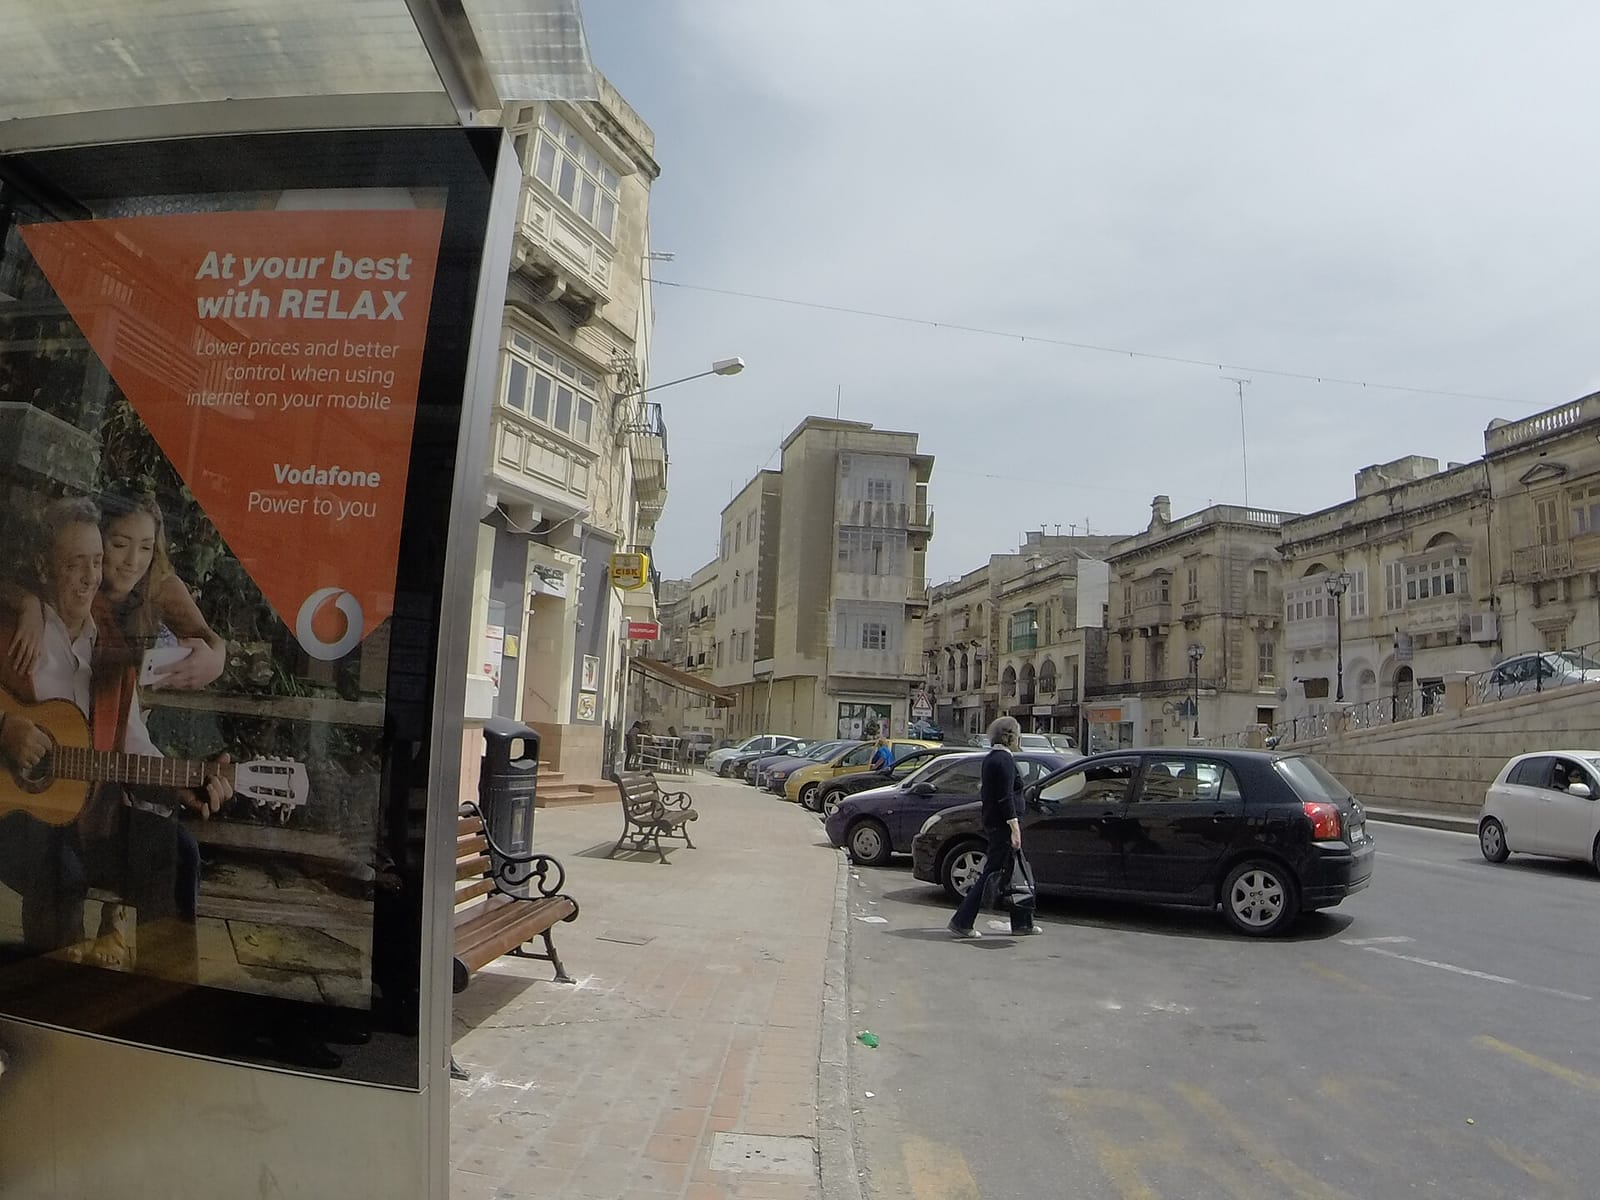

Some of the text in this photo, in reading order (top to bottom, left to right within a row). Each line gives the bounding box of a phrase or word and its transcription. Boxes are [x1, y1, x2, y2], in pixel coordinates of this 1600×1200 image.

[195, 251, 412, 286] At your best
[197, 289, 408, 321] with RELAX
[196, 339, 400, 359] Lower prices and better
[225, 364, 395, 389] control when using
[186, 390, 392, 411] internet on your mobile
[273, 463, 381, 487] Vodafone
[247, 491, 377, 521] Power to you
[615, 568, 638, 576] CISK
